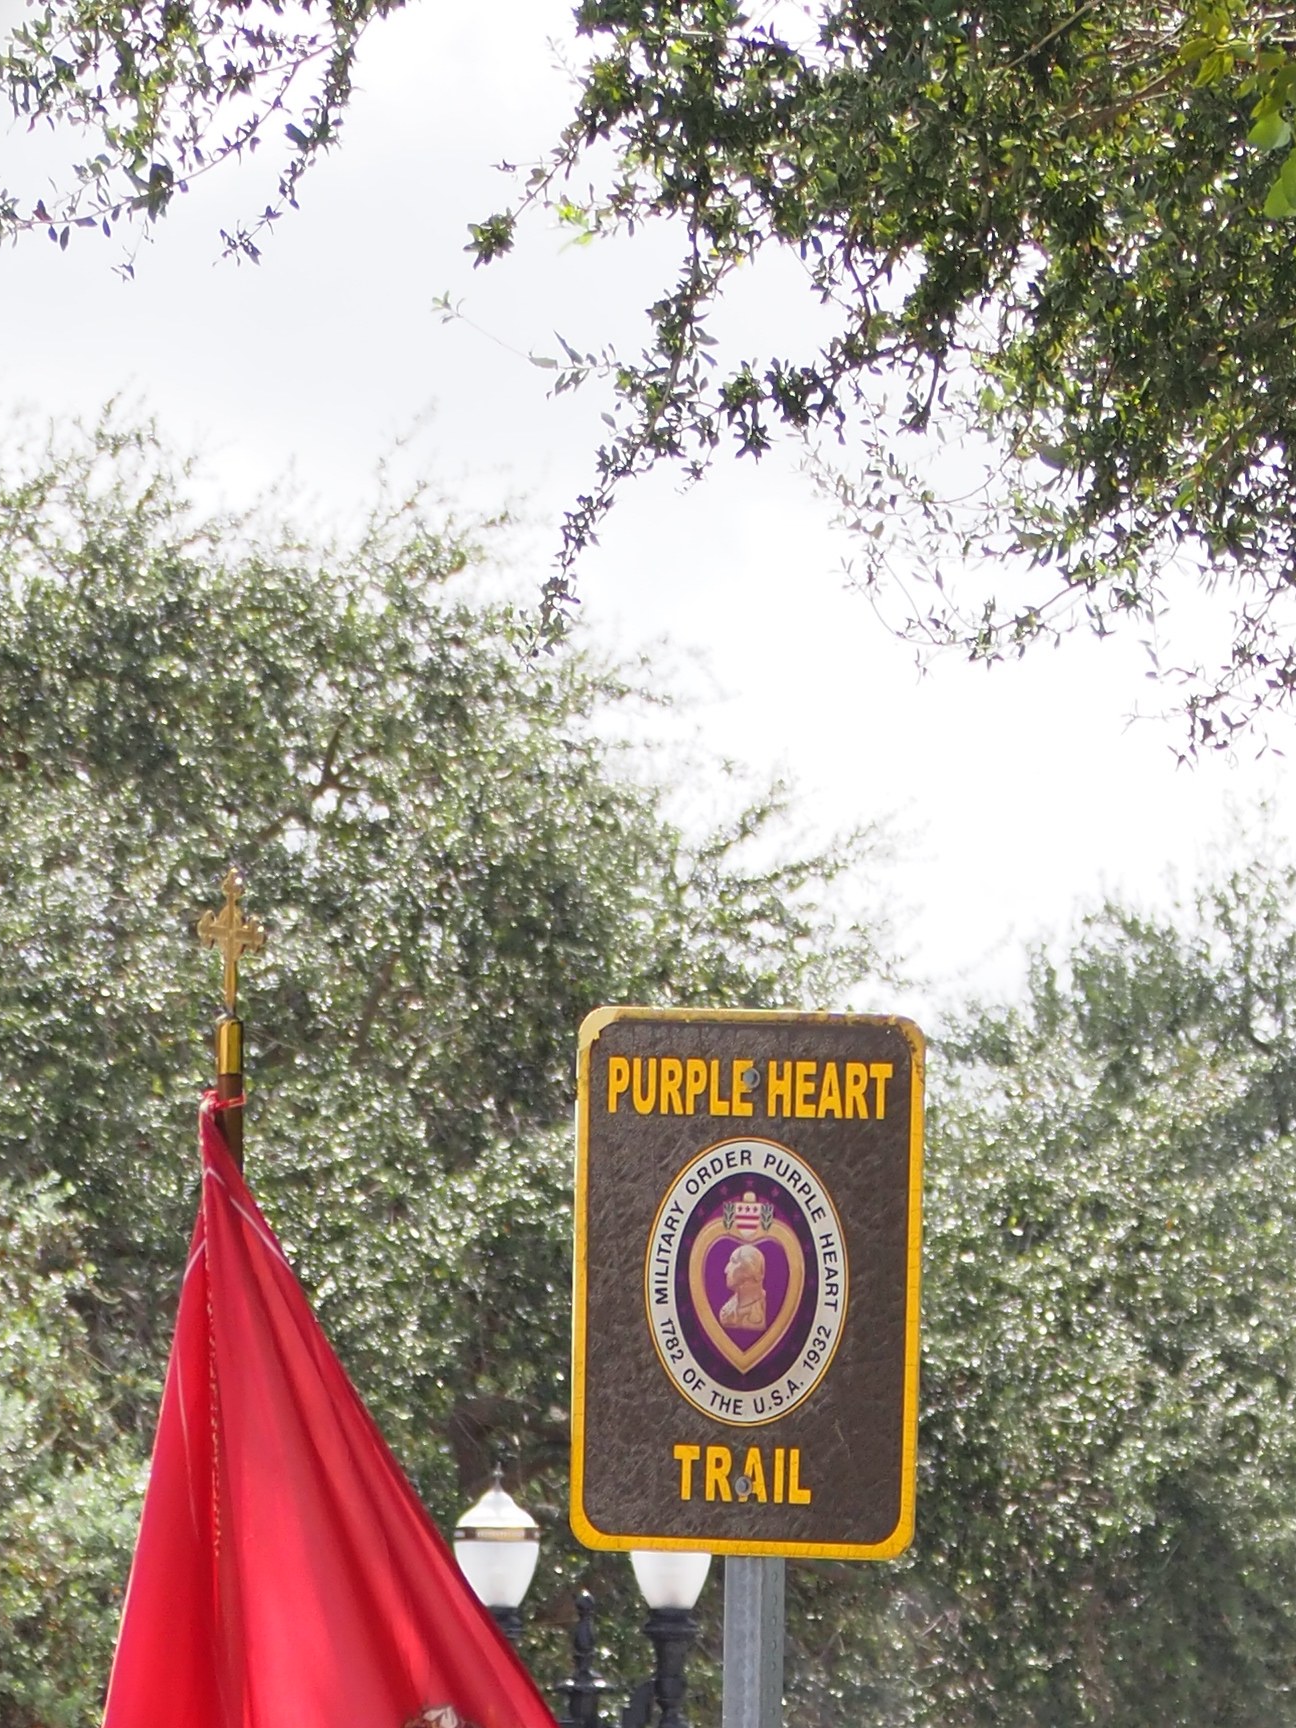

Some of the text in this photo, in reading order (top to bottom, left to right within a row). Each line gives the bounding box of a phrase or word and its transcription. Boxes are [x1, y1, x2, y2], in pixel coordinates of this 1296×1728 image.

[607, 1056, 894, 1120] PURPLE HEART
[655, 1150, 840, 1312] MILITARY ORDER PURPLE HEART
[660, 1318, 832, 1415] 1782 OF THE U.S.A. 1932
[673, 1445, 812, 1505] TRAIL
